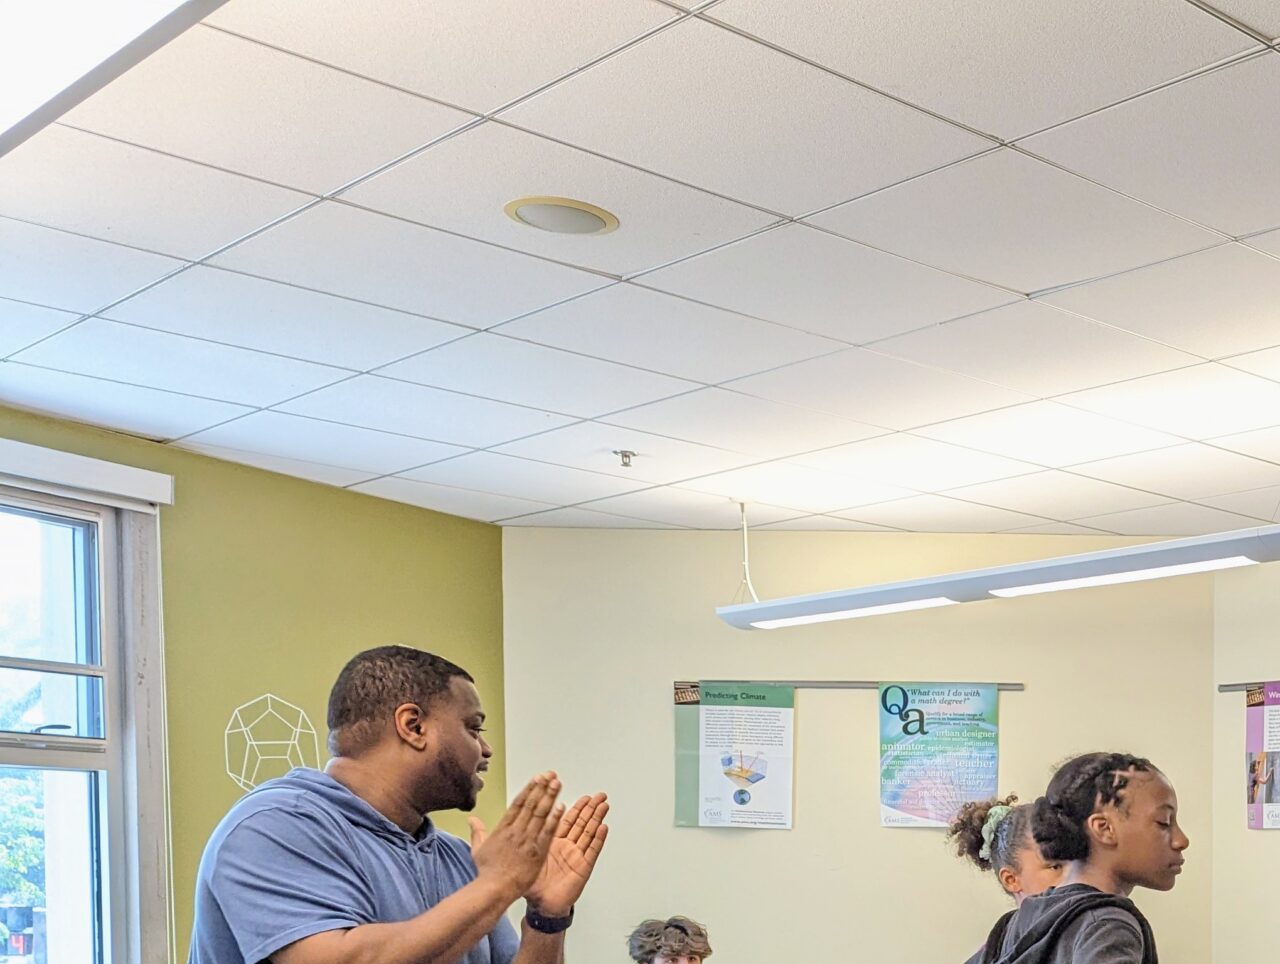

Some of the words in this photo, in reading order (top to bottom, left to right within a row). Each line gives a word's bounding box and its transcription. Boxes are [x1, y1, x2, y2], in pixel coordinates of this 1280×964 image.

[705, 691, 738, 701] Predicting
[740, 692, 767, 701] Climate
[946, 689, 951, 697] I
[952, 689, 962, 697] do
[963, 689, 981, 697] with
[881, 684, 909, 722] Q
[918, 696, 937, 704] math
[936, 729, 960, 737] urban
[961, 730, 997, 739] designer
[881, 742, 926, 751] animator
[954, 758, 995, 768] teacher
[881, 777, 911, 785] banker
